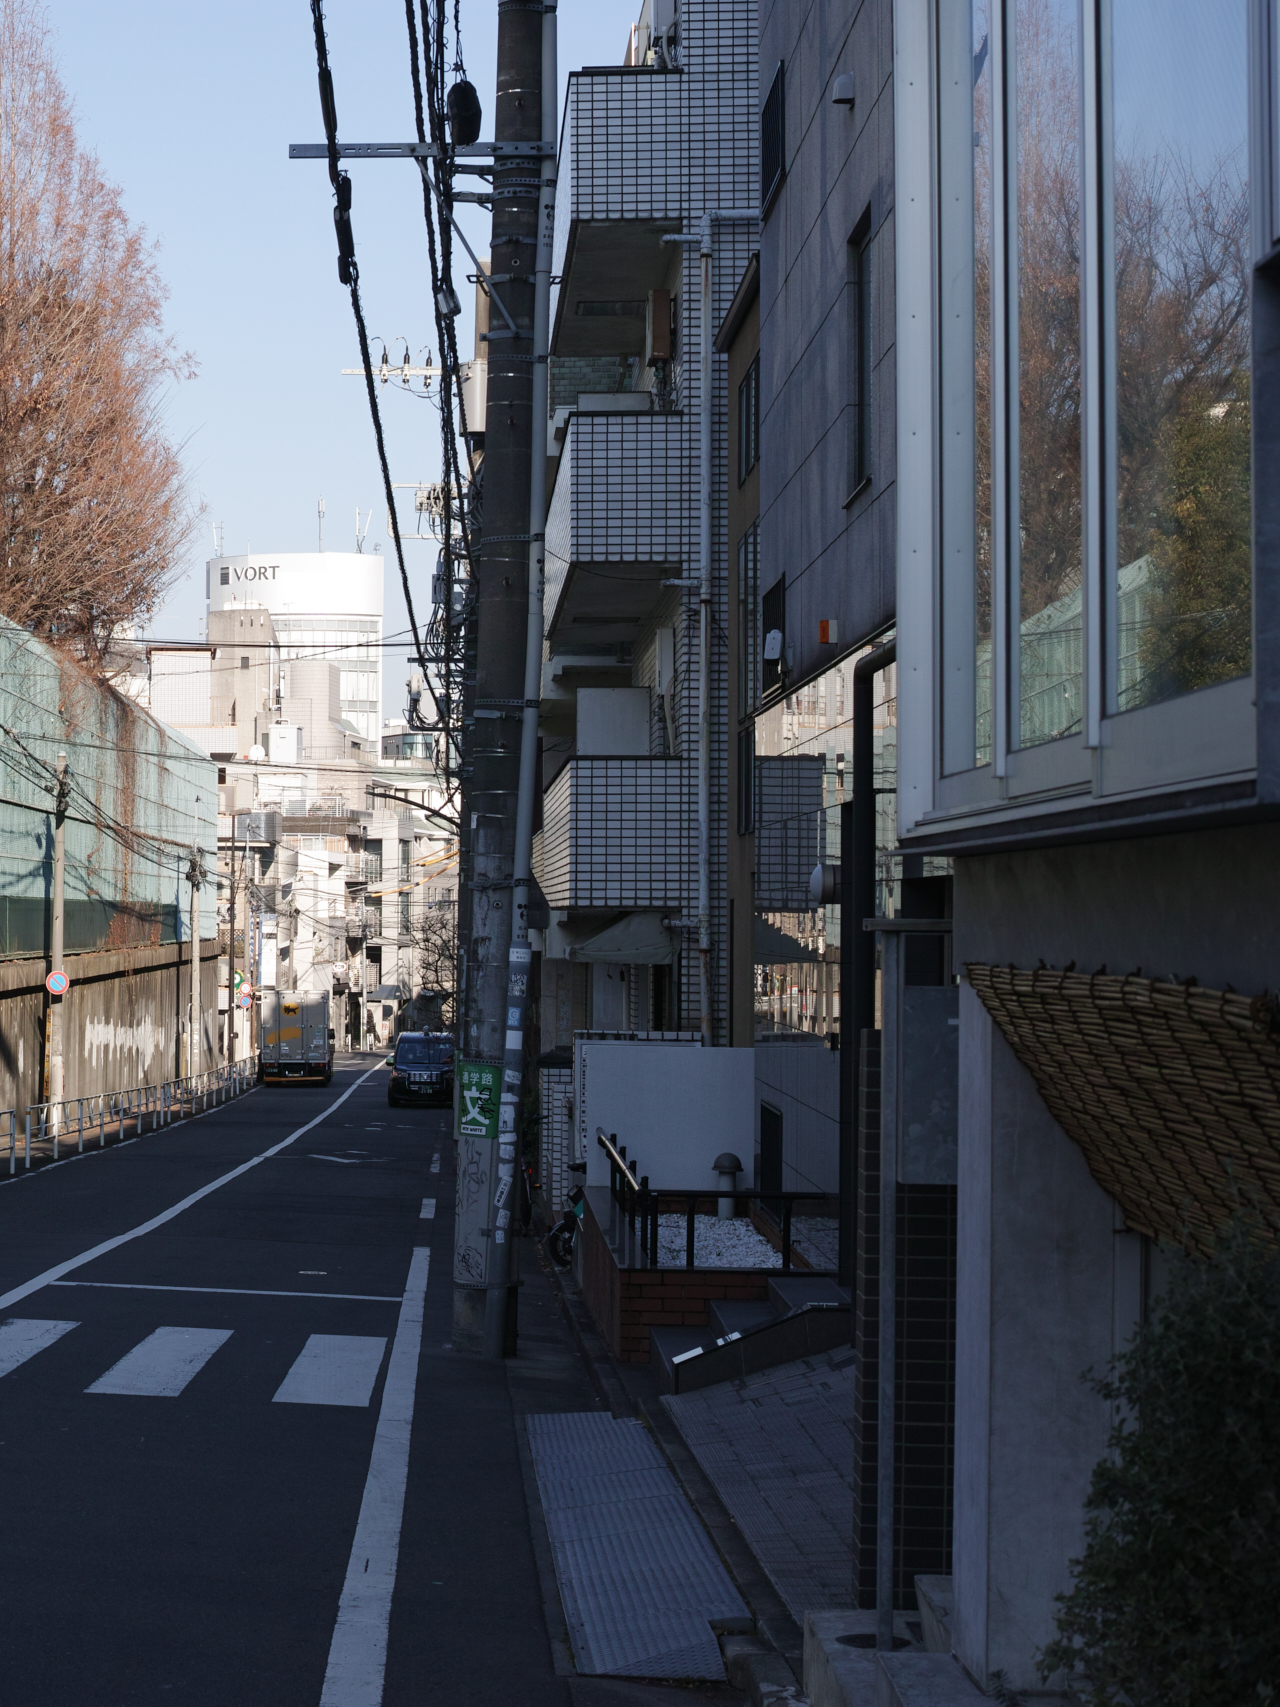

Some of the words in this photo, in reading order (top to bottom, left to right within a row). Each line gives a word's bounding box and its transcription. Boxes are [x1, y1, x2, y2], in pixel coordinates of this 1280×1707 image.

[234, 565, 280, 581] VORT
[462, 1072, 493, 1085] 通学路
